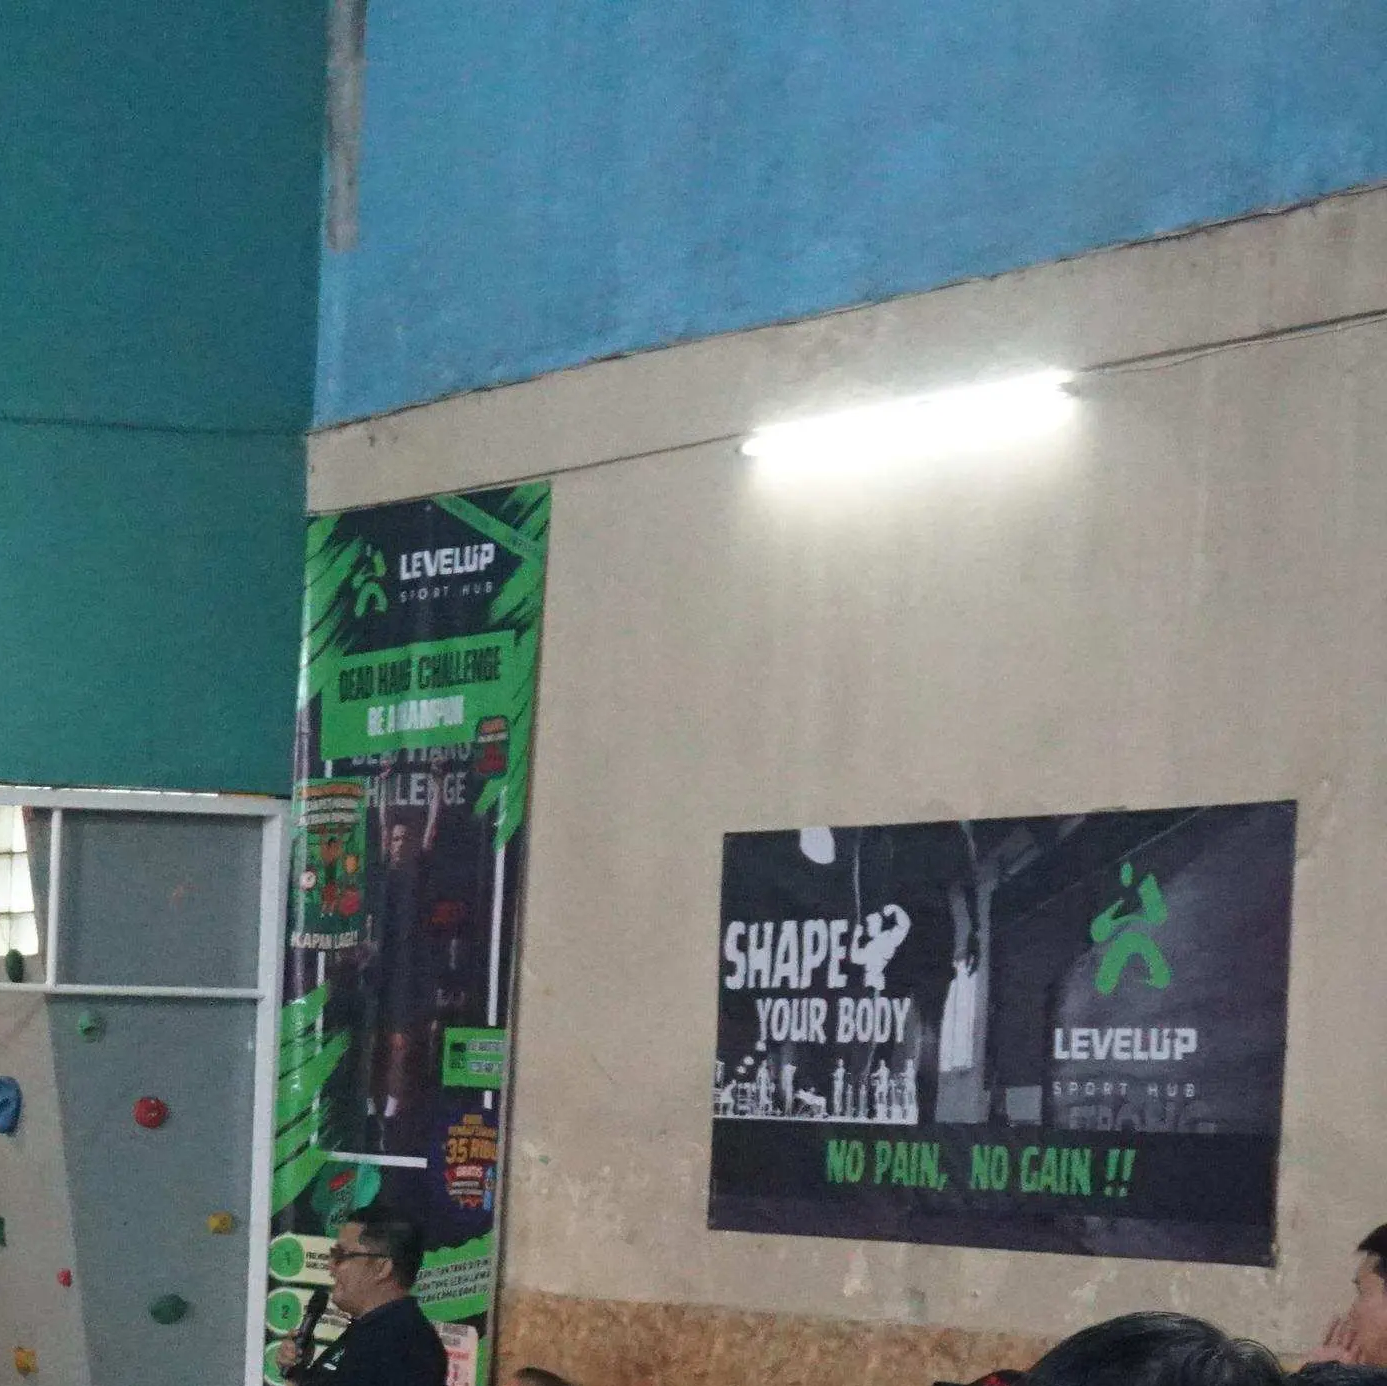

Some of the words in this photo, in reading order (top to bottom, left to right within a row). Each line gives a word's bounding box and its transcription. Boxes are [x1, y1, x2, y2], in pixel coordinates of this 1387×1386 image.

[399, 543, 495, 581] LEVELUP
[462, 581, 493, 597] HUB
[418, 646, 501, 689] CHALLENGE
[724, 919, 849, 990] SHAPE
[756, 997, 827, 1044] YOUR
[836, 996, 911, 1043] BODY
[1053, 1027, 1198, 1061] LEVELUP
[1053, 1081, 1127, 1097] SPORT
[1147, 1082, 1196, 1098] HUB
[827, 1139, 865, 1184] NO
[874, 1140, 948, 1191] PAIN,
[971, 1144, 1010, 1190] NO
